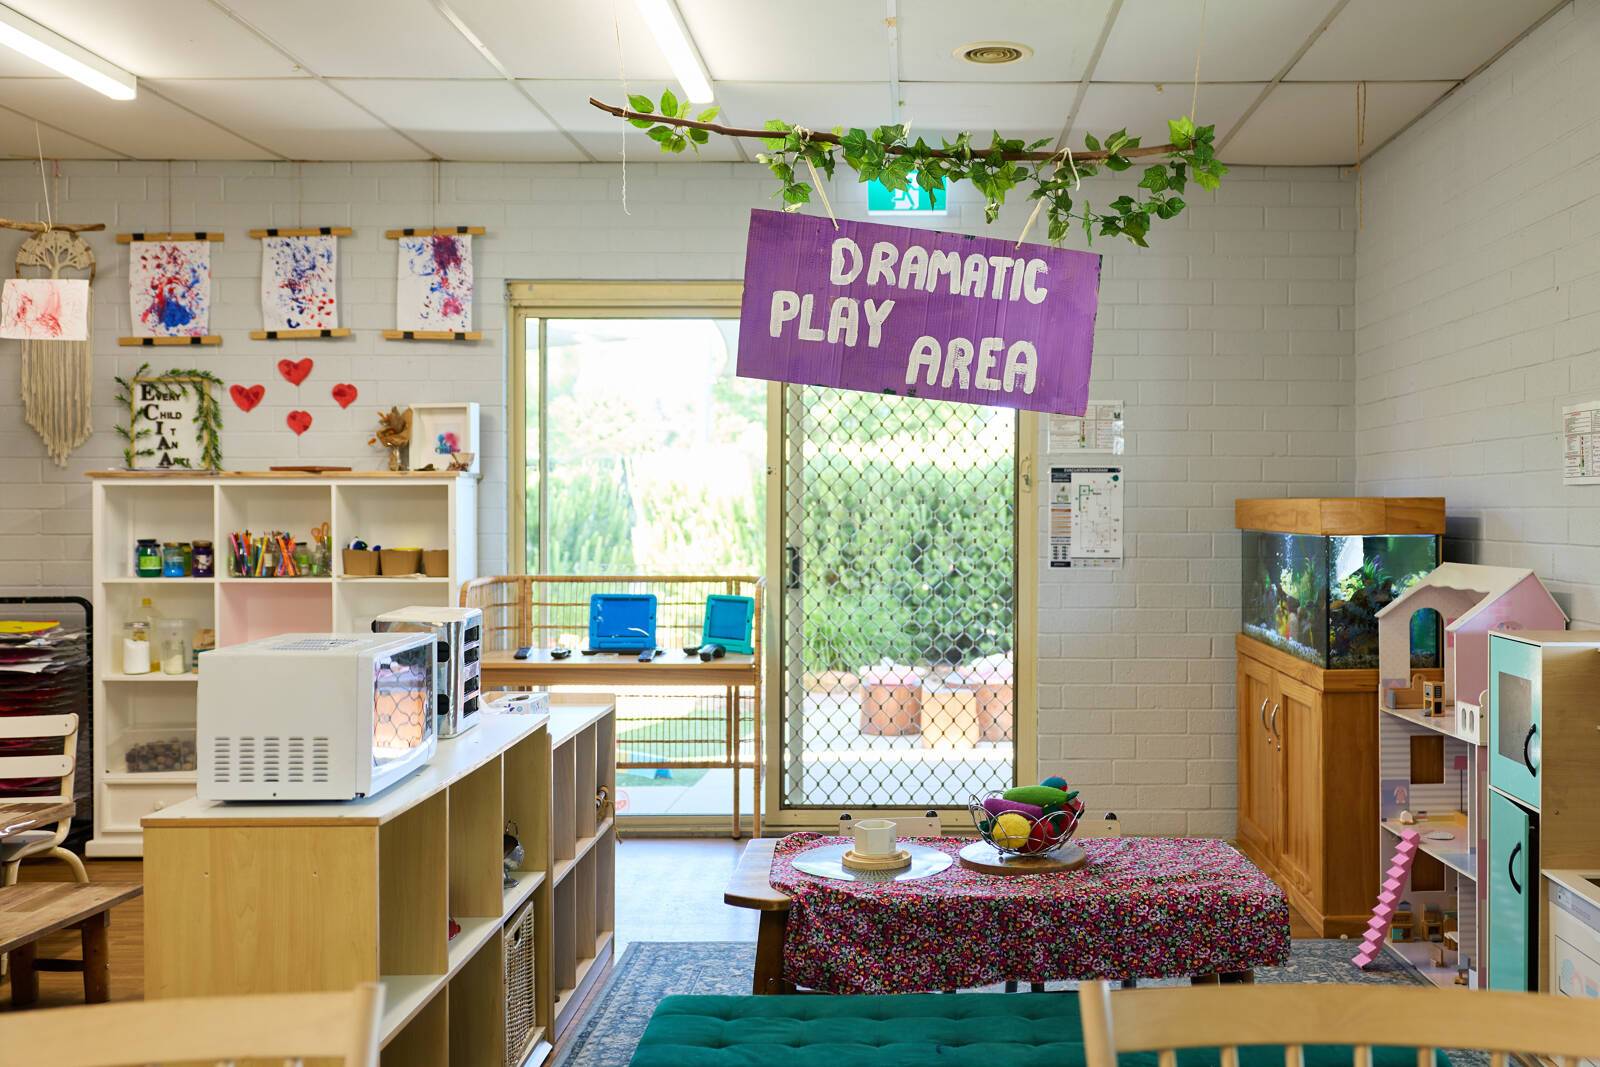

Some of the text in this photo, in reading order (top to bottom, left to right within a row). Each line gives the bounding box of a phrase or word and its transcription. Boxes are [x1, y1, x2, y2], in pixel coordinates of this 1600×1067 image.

[830, 237, 1048, 305] DRAMATIC
[770, 290, 896, 348] PLAY
[905, 335, 1038, 395] AREA
